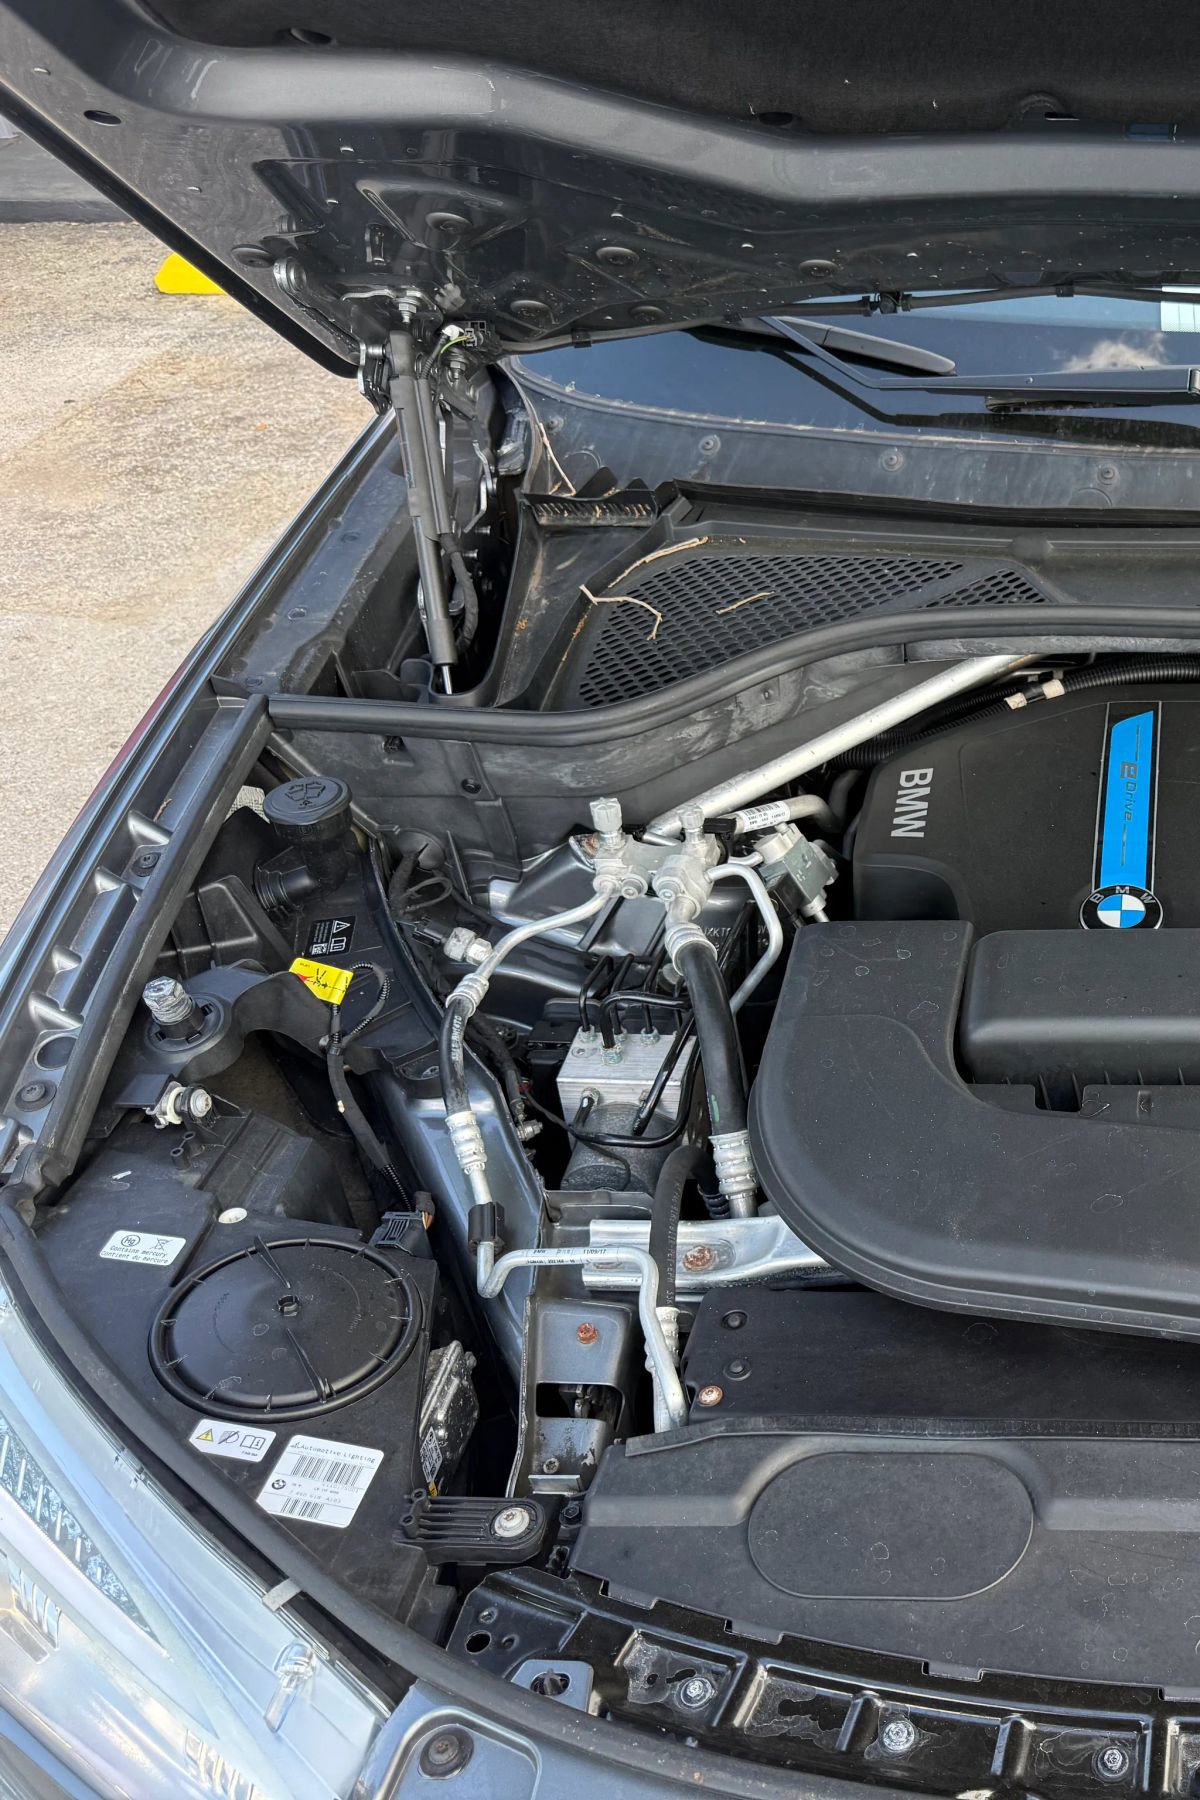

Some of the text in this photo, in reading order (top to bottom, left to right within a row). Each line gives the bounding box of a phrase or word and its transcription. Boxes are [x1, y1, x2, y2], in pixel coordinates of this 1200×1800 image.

[890, 768, 934, 838] BMW
[1089, 886, 1157, 904] BMW
[110, 1245, 169, 1258] Contains mercury
[301, 1444, 376, 1464] Automotive Lighting
